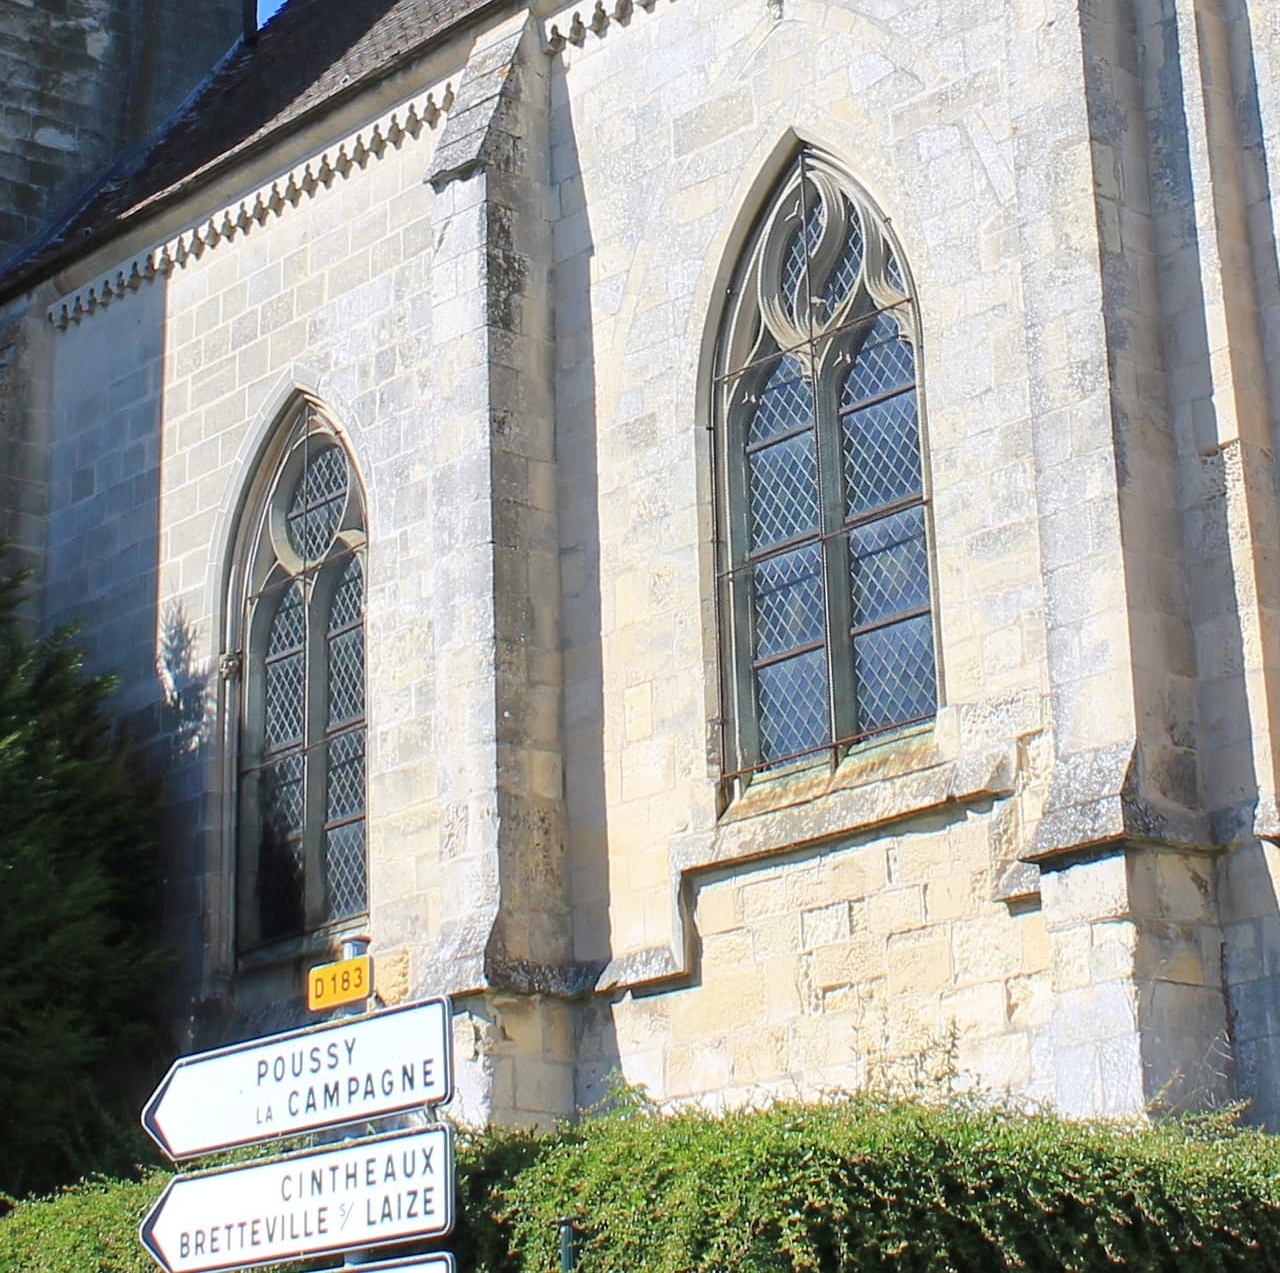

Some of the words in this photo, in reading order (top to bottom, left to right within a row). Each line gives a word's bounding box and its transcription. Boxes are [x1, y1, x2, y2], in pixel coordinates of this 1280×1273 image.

[315, 978, 324, 999] D
[331, 967, 363, 994] 183
[257, 1038, 357, 1086] POUSSY
[256, 1106, 273, 1125] LA
[288, 1058, 435, 1117] CAMPAGNE
[281, 1146, 435, 1202] CINTHEAUX
[180, 1206, 329, 1259] BRETTEVILLE
[367, 1186, 435, 1226] LAIZE
